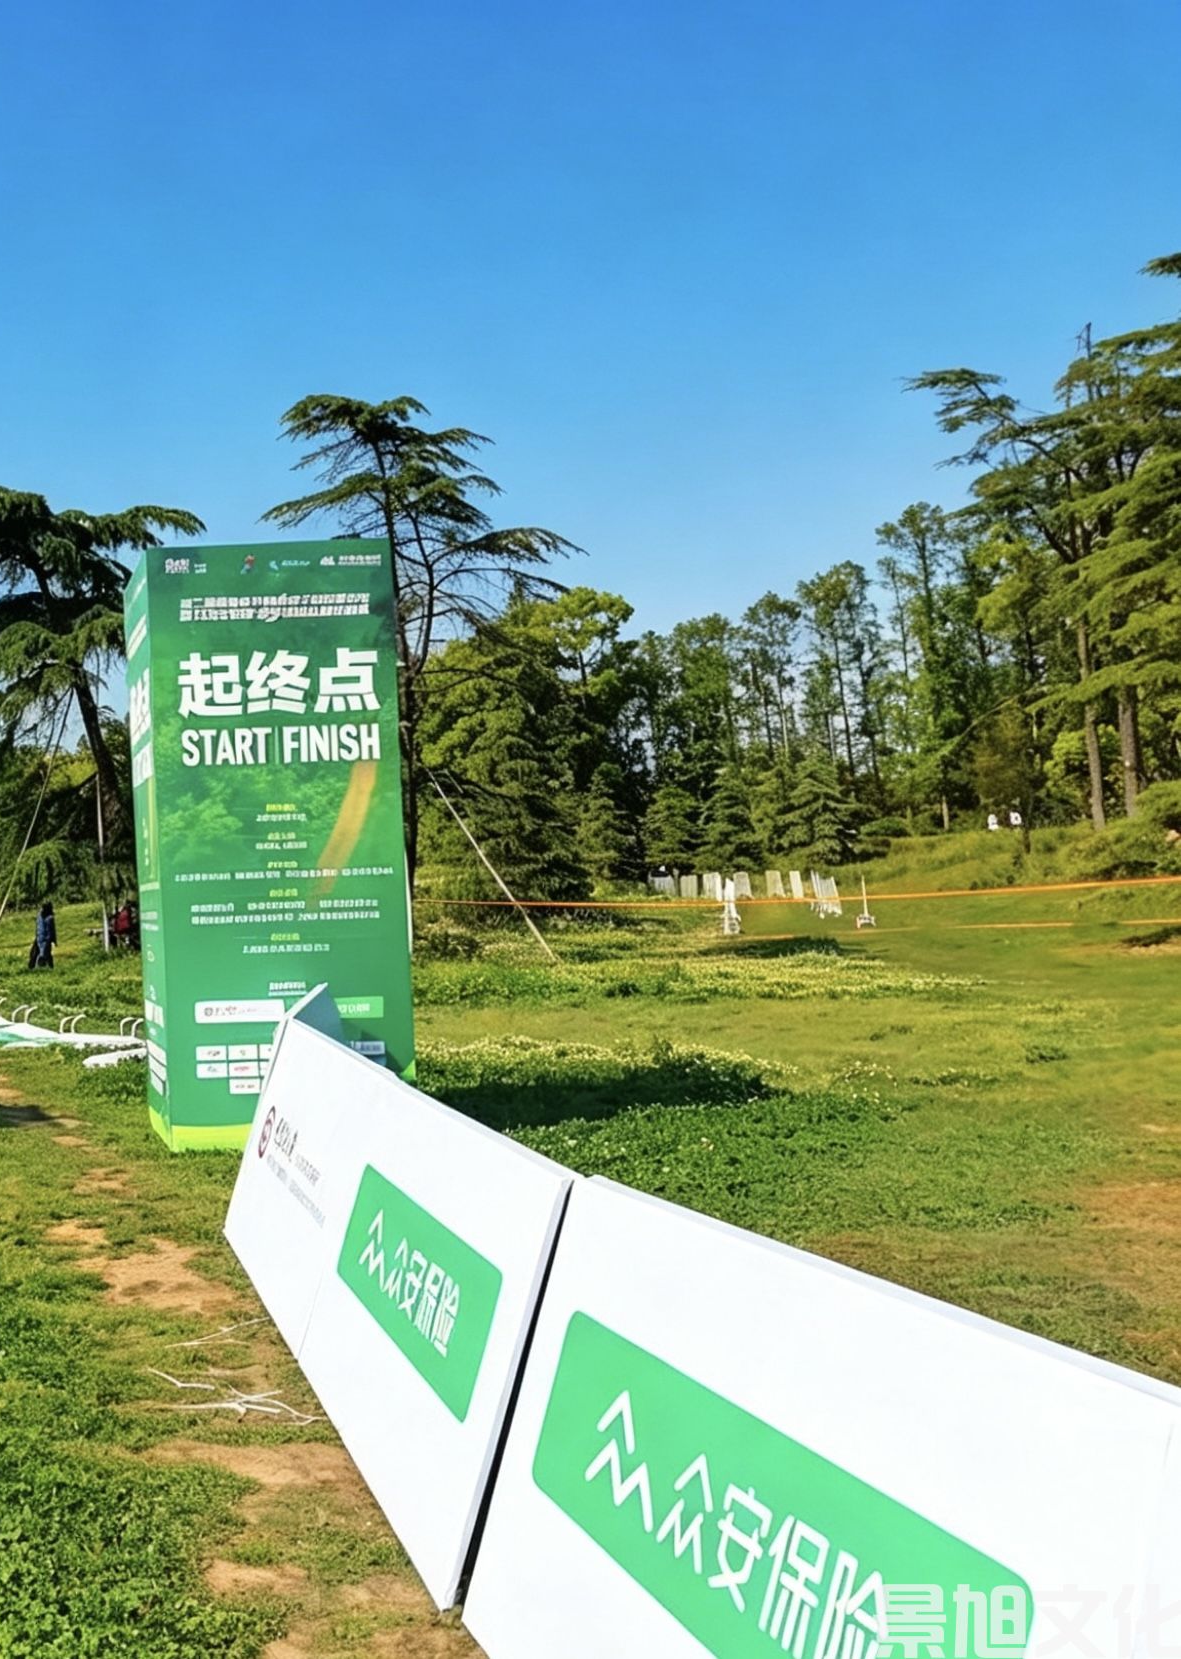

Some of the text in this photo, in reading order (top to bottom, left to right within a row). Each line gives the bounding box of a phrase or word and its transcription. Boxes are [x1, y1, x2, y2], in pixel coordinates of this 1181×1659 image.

[177, 647, 381, 719] 起终点
[181, 727, 272, 767] START
[282, 723, 381, 764] FINISH
